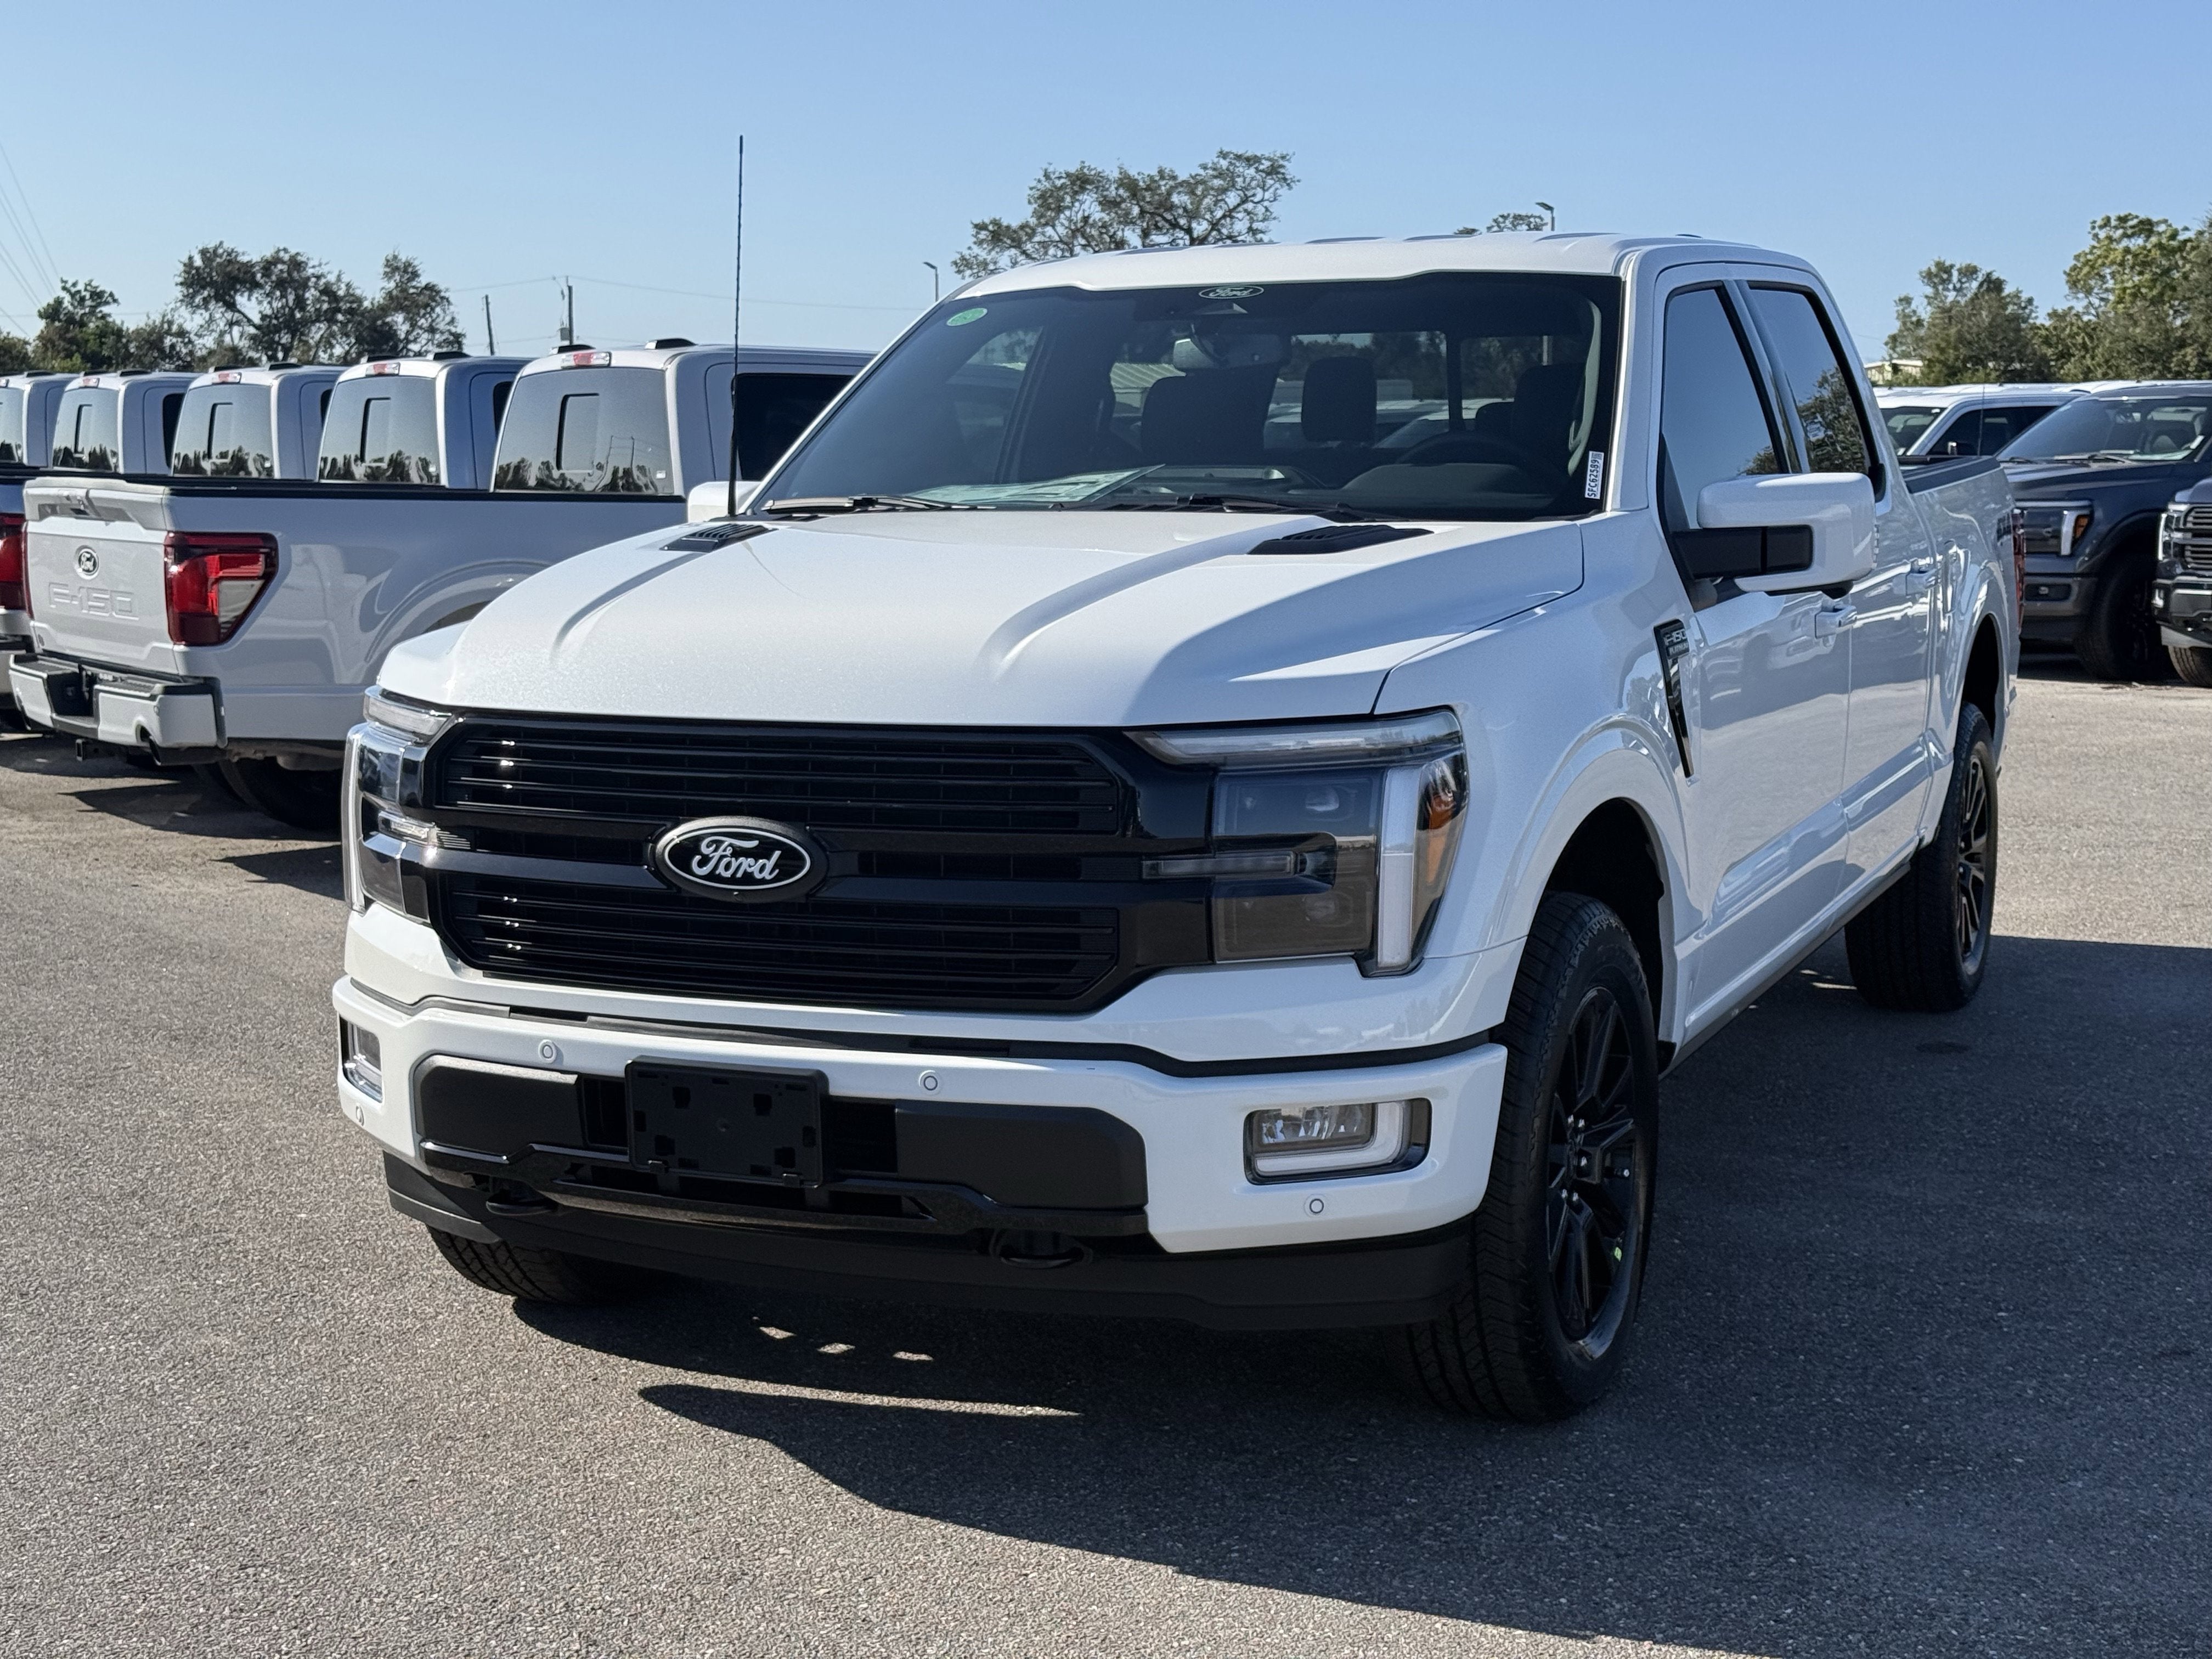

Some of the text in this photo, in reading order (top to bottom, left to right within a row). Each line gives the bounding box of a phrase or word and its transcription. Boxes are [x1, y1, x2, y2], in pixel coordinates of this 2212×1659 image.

[1208, 287, 1254, 297] Ford
[1587, 459, 1600, 498] SFC62589
[48, 582, 139, 620] F-150
[692, 836, 782, 880] Ford
